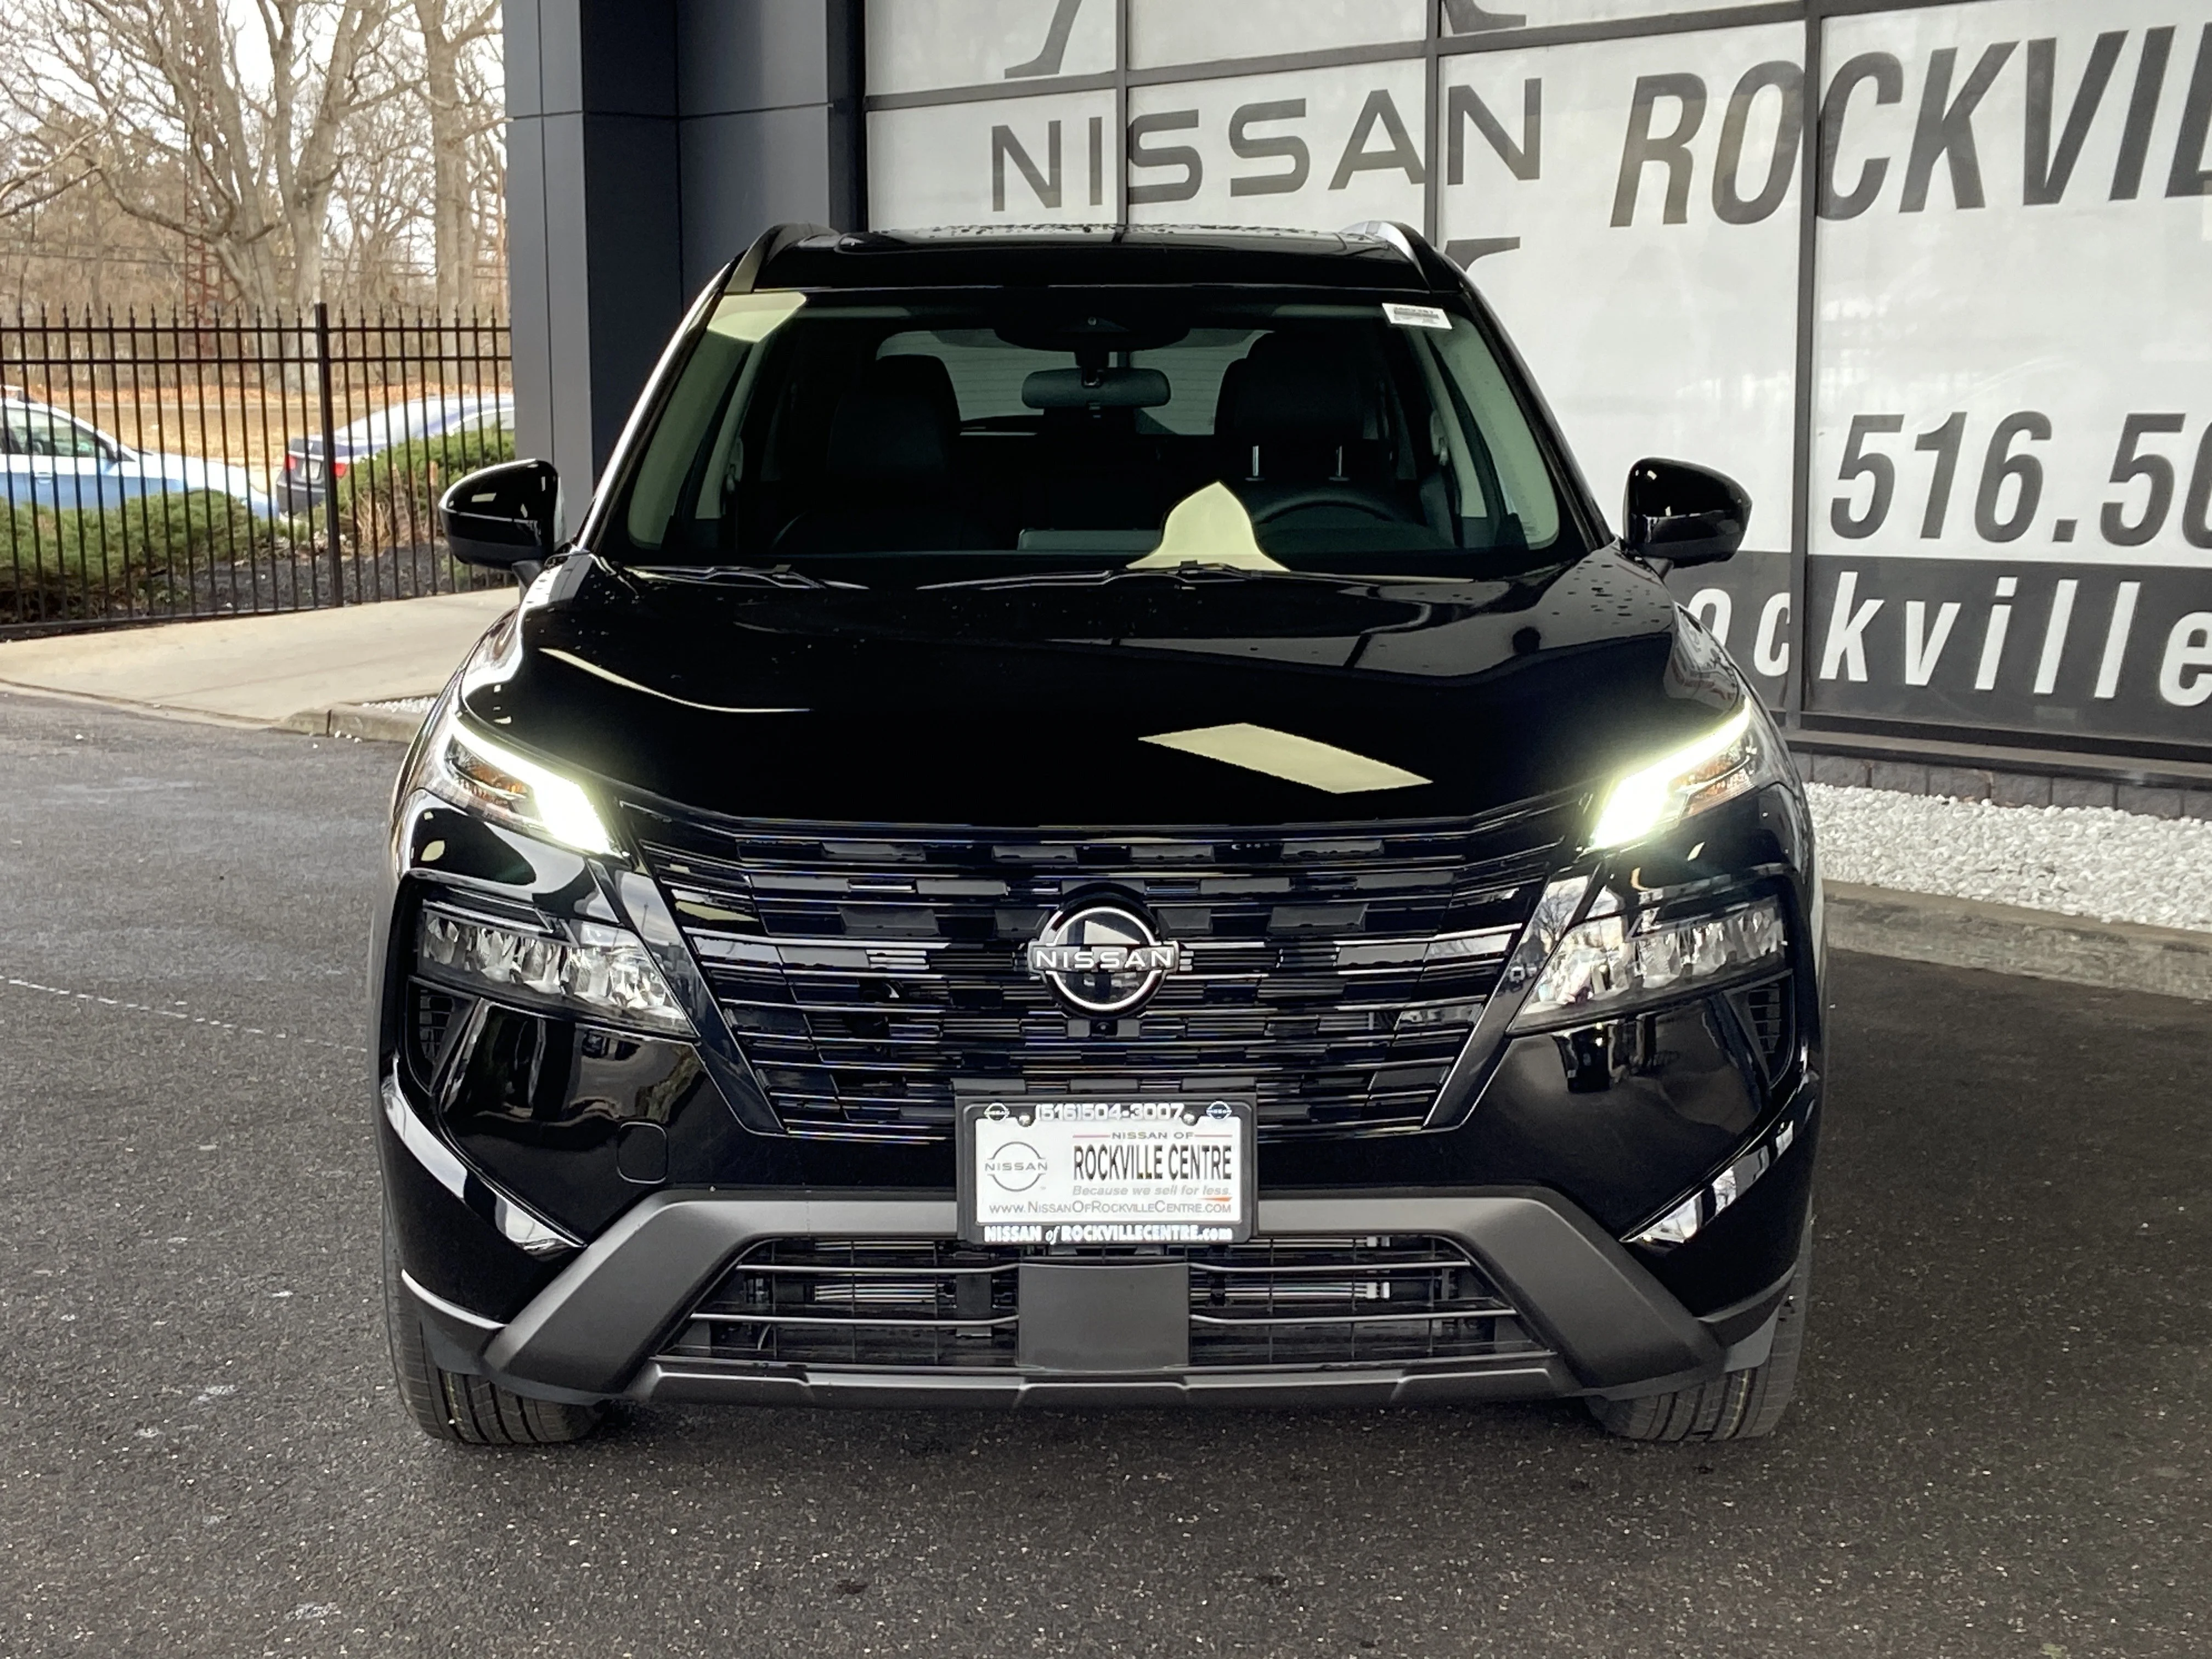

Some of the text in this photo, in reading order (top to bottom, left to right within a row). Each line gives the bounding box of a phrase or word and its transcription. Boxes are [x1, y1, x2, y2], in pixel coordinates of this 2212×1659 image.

[1610, 22, 2212, 227] ROCKVIL
[992, 77, 1542, 212] NISSAN
[1036, 949, 1171, 968] NISSAN
[1111, 1131, 1194, 1139] NISSAN OF
[984, 1161, 1048, 1172] NISSAN
[1074, 1143, 1232, 1181] ROCKVILLE CENTRE
[1072, 1185, 1232, 1195] Because we sell for less.
[984, 1223, 1233, 1246] NISSAN of ROCKVILLECENTRE.com
